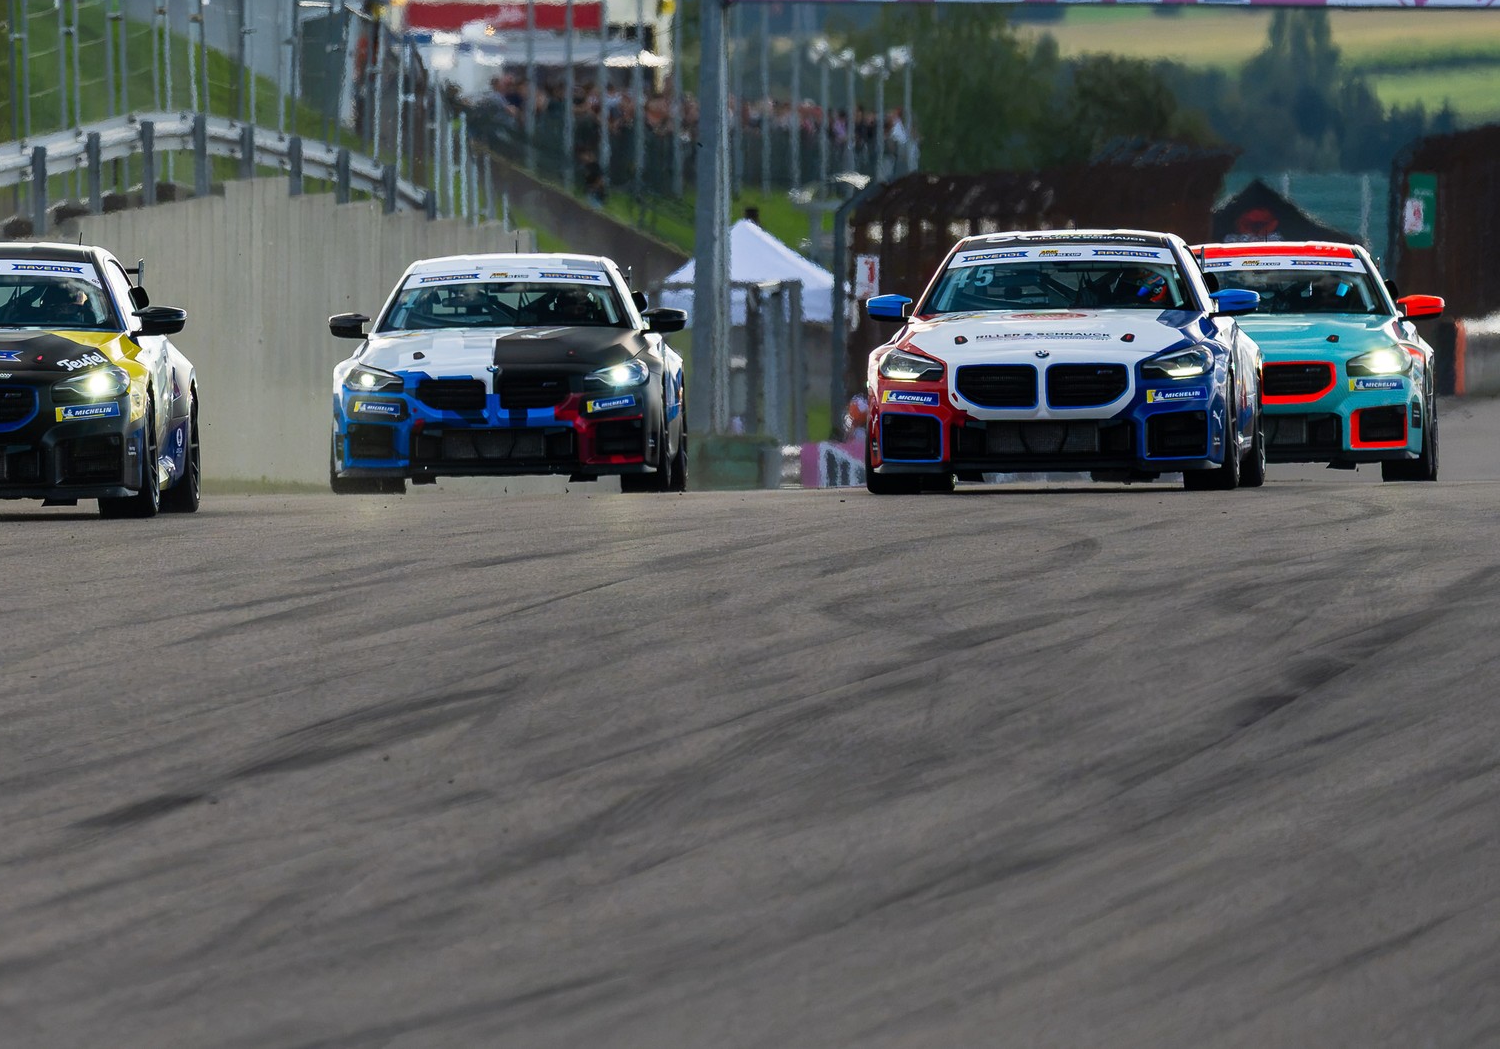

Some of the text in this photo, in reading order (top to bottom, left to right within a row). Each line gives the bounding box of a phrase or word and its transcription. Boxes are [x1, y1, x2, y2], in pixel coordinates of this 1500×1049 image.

[967, 252, 1026, 261] RAVENOL
[1096, 250, 1157, 258] RAVENOL
[19, 264, 79, 273] RAVENOL
[56, 351, 109, 372] Teufel
[897, 394, 933, 402] MICHELIN
[1164, 390, 1201, 398] MICHELIN
[74, 407, 112, 416] MICHELIN
